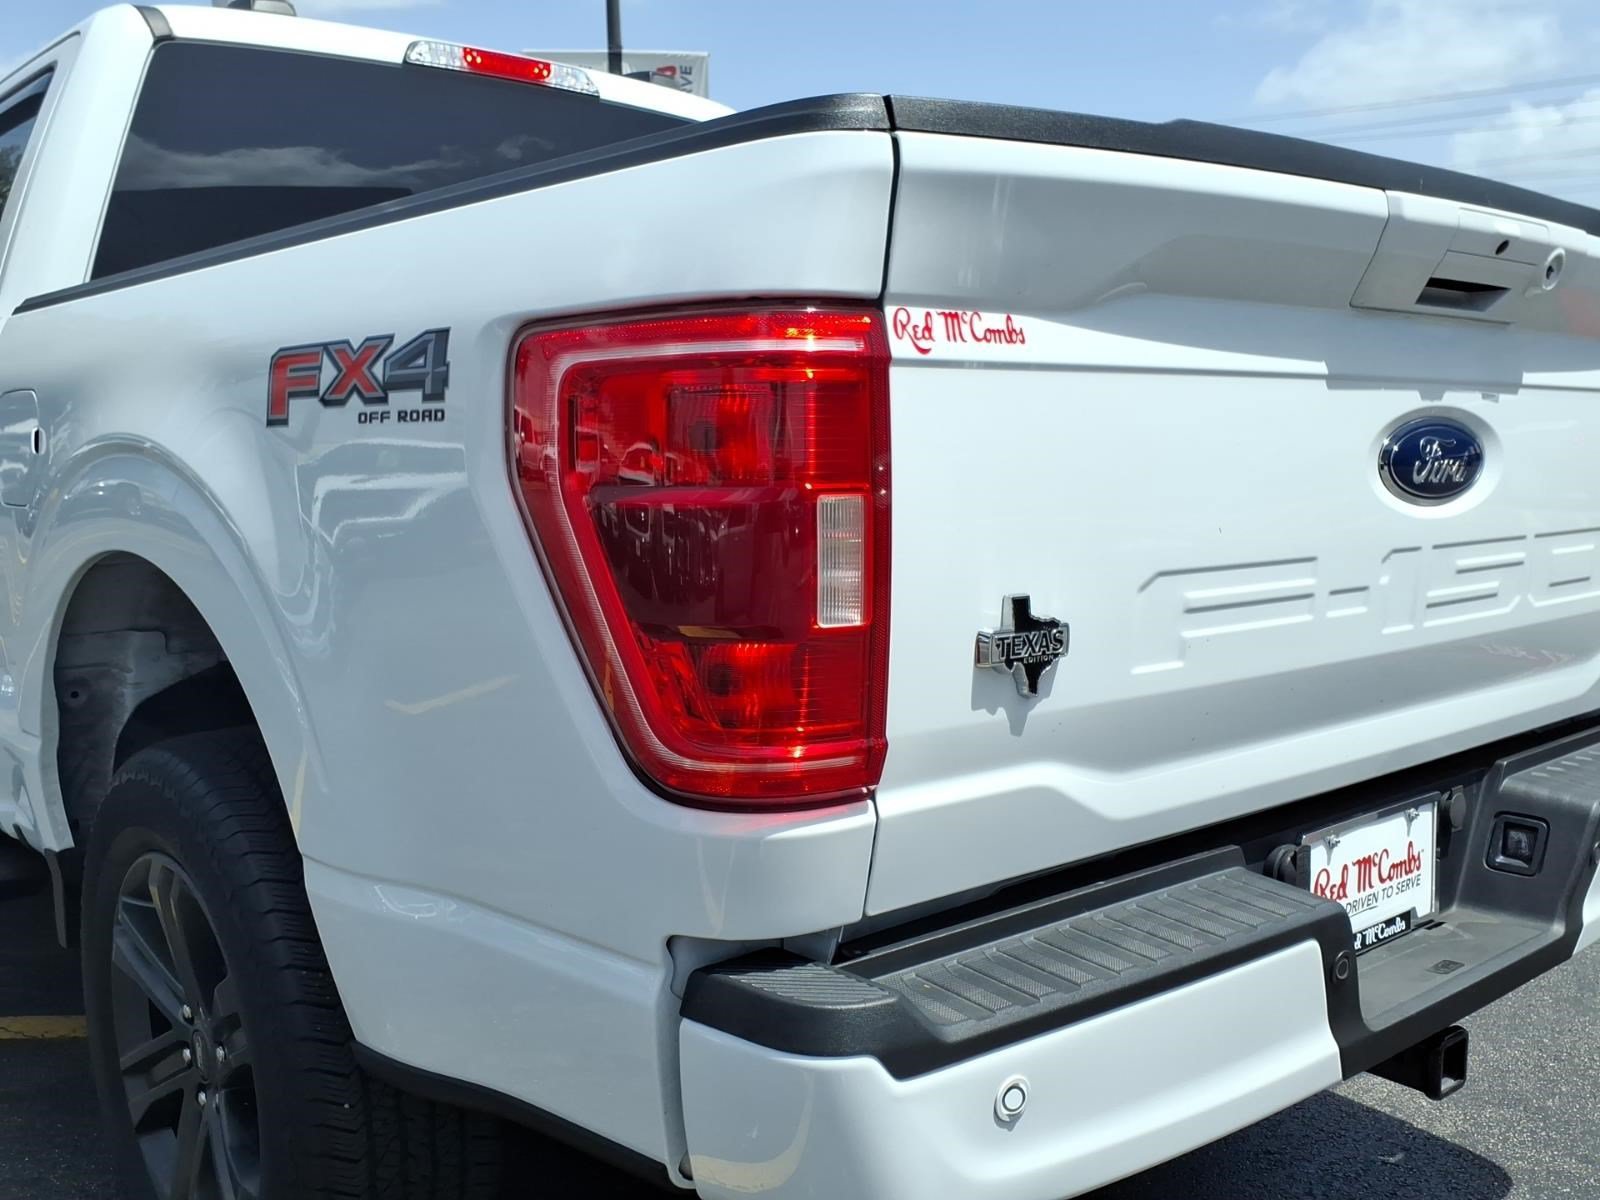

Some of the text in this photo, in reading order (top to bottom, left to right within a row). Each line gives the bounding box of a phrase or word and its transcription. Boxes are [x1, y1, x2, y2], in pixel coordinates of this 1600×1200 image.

[893, 307, 1026, 355] Red McCombs
[266, 326, 451, 428] FX4
[358, 408, 445, 424] OFF ROAD
[1412, 436, 1468, 484] Ford
[994, 628, 1064, 661] TEXAS
[1023, 654, 1055, 664] EDITION
[1314, 840, 1421, 902] Red McCombs
[1345, 874, 1421, 916] DRIVEN TO SERVE
[1362, 916, 1406, 946] McCombs
